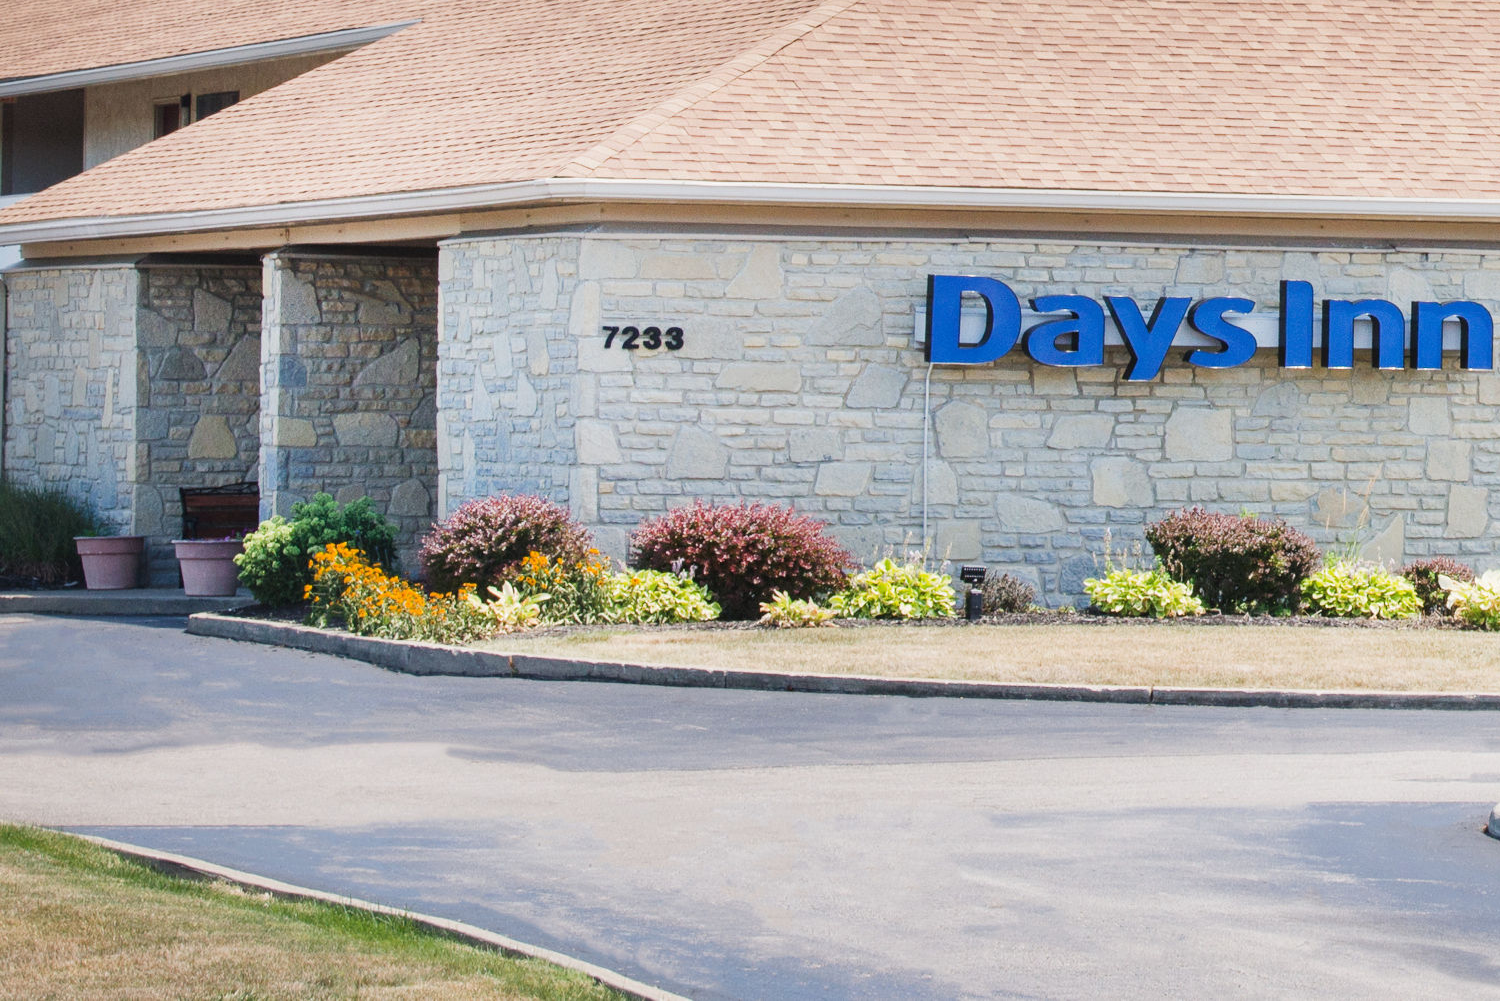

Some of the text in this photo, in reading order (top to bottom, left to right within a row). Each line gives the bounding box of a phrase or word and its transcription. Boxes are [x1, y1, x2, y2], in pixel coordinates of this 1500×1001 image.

[602, 325, 684, 350] 7233
[924, 274, 1494, 382] Days Inn
